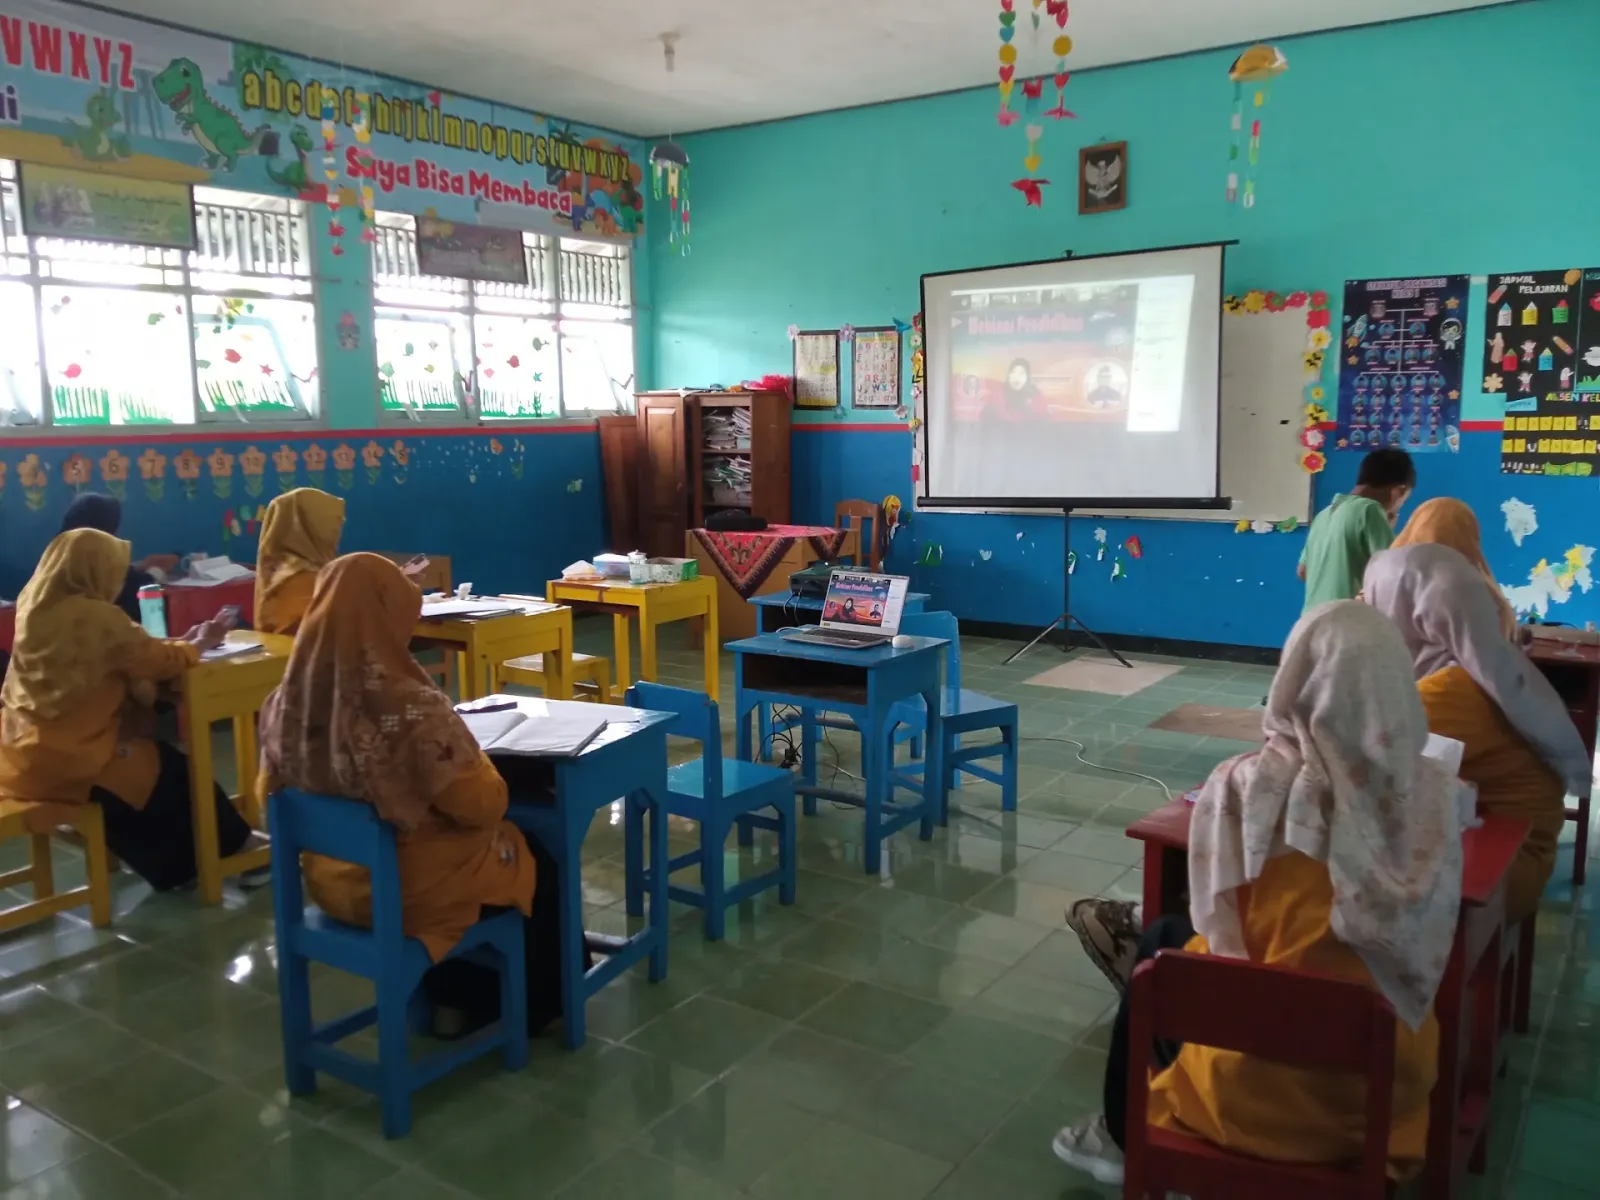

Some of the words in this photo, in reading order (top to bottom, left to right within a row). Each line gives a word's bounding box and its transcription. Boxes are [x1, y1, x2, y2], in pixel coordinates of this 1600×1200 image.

[415, 159, 465, 196] Bisa
[469, 169, 572, 215] Membaca
[109, 459, 118, 474] 6
[216, 457, 225, 470] 9
